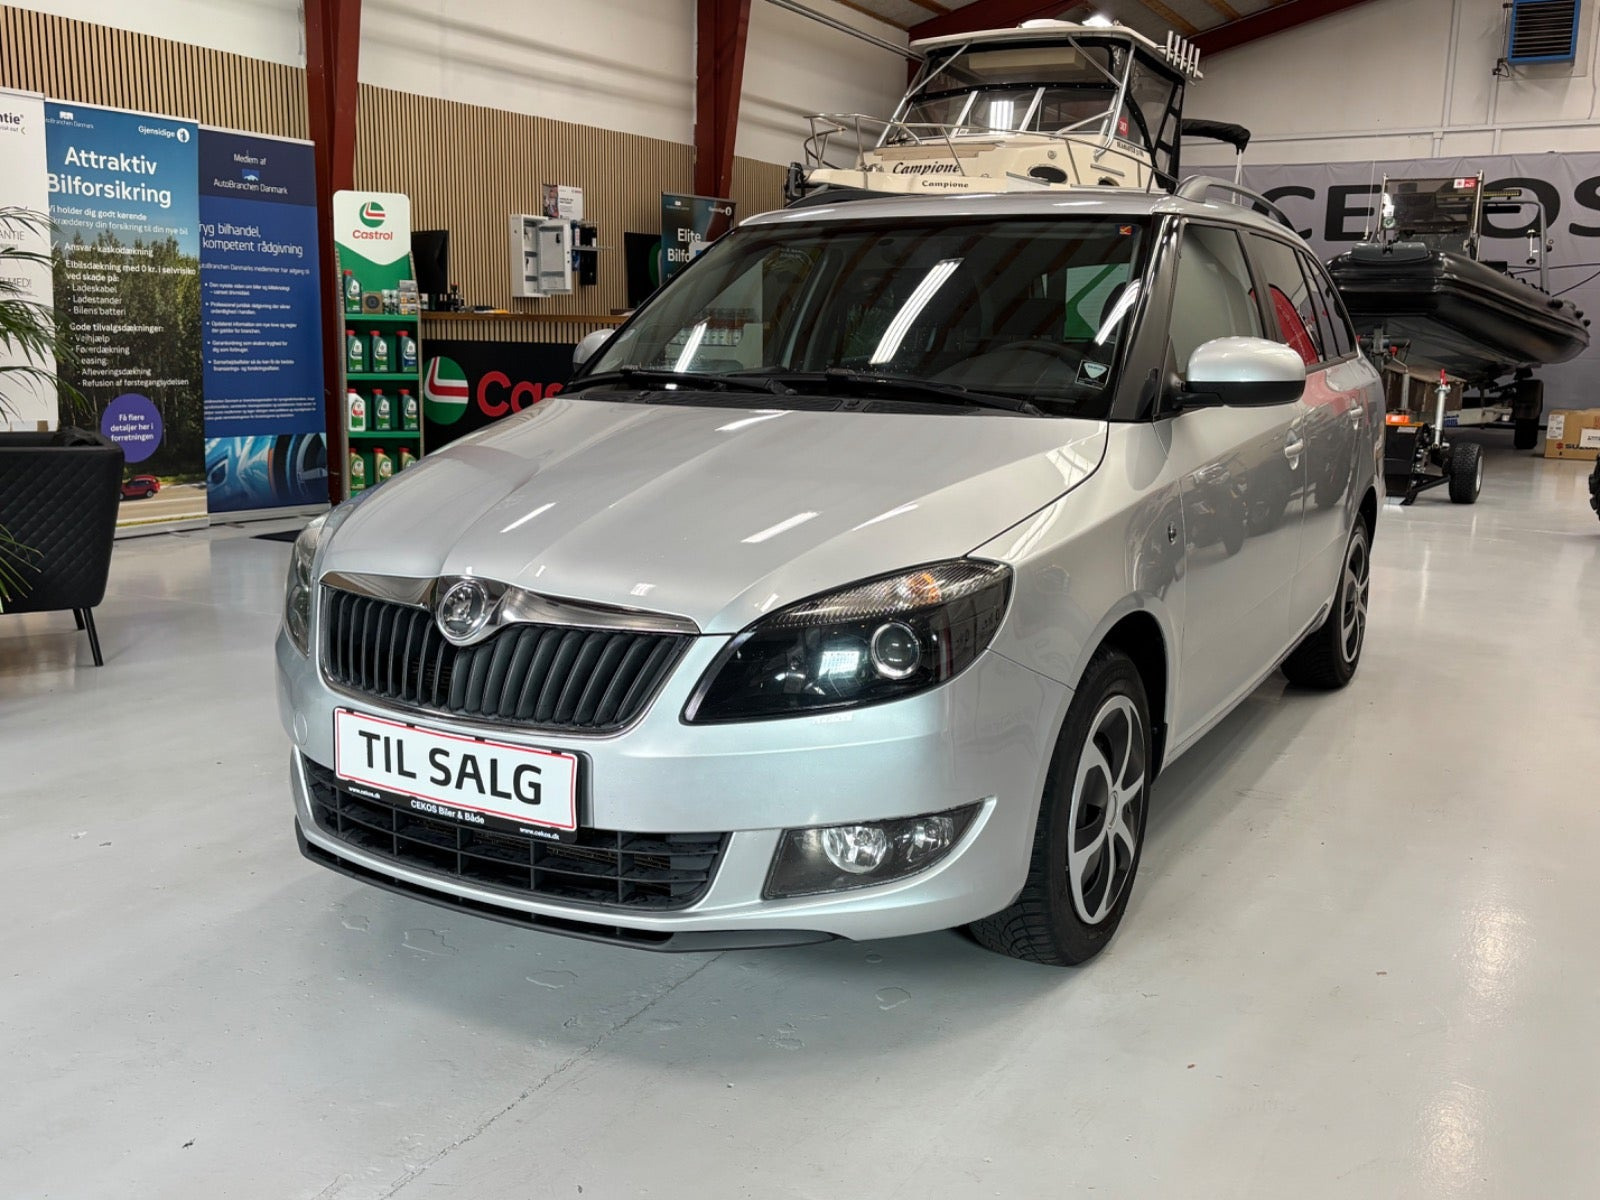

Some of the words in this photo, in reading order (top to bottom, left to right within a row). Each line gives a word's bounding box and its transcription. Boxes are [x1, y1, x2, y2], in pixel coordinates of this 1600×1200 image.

[138, 125, 175, 138] Gjensidige
[64, 146, 157, 174] Attraktiv
[234, 153, 258, 165] Medlem
[260, 158, 267, 166] af
[892, 161, 960, 175] Campione
[47, 173, 171, 208] Bilforsikring
[214, 178, 259, 192] AutoBranchen
[260, 184, 288, 195] Danmark
[922, 180, 969, 188] Campione
[57, 206, 82, 215] holder
[84, 208, 96, 218] dig
[98, 209, 116, 219] godt
[117, 211, 147, 221] kørende
[1252, 177, 1600, 241] CEO
[95, 221, 107, 229] din
[109, 222, 143, 233] forsikring
[153, 224, 165, 233] din
[166, 226, 177, 235] nye
[178, 226, 189, 235] bil
[218, 222, 261, 238] bilhandel,
[352, 230, 393, 240] Castrol
[678, 228, 701, 242] Elite
[97, 244, 153, 258] kaskodækning
[203, 237, 254, 252] kompetent
[258, 241, 303, 258] rådgivning
[65, 260, 122, 273] Elbilsdækning
[122, 263, 140, 272] med
[141, 265, 147, 273] 0
[148, 265, 157, 273] kr.
[162, 266, 196, 275] selvrisiko
[66, 272, 82, 281] ved
[83, 273, 106, 282] skade
[107, 274, 120, 286] på:
[72, 283, 117, 294] Ladeskabel
[72, 295, 122, 305] Ladestander
[73, 306, 99, 316] Bilens
[100, 307, 126, 316] batteri
[69, 322, 92, 332] Gode
[77, 358, 108, 366] easing:
[82, 368, 152, 377] Afleveringsdækning
[82, 379, 114, 388] Refusion
[124, 378, 189, 388] førstegangsydelsen
[119, 413, 127, 422] Få
[110, 424, 137, 433] detaljer
[111, 433, 154, 442] forretningen
[358, 730, 417, 780] TIL
[429, 747, 542, 805] SALG
[348, 786, 381, 799] www.cekos.dk
[410, 800, 437, 814] CEKOS
[439, 806, 456, 818] Biler
[457, 810, 463, 820] &
[465, 812, 485, 824] Både
[520, 827, 560, 840] www.cekos.dk
